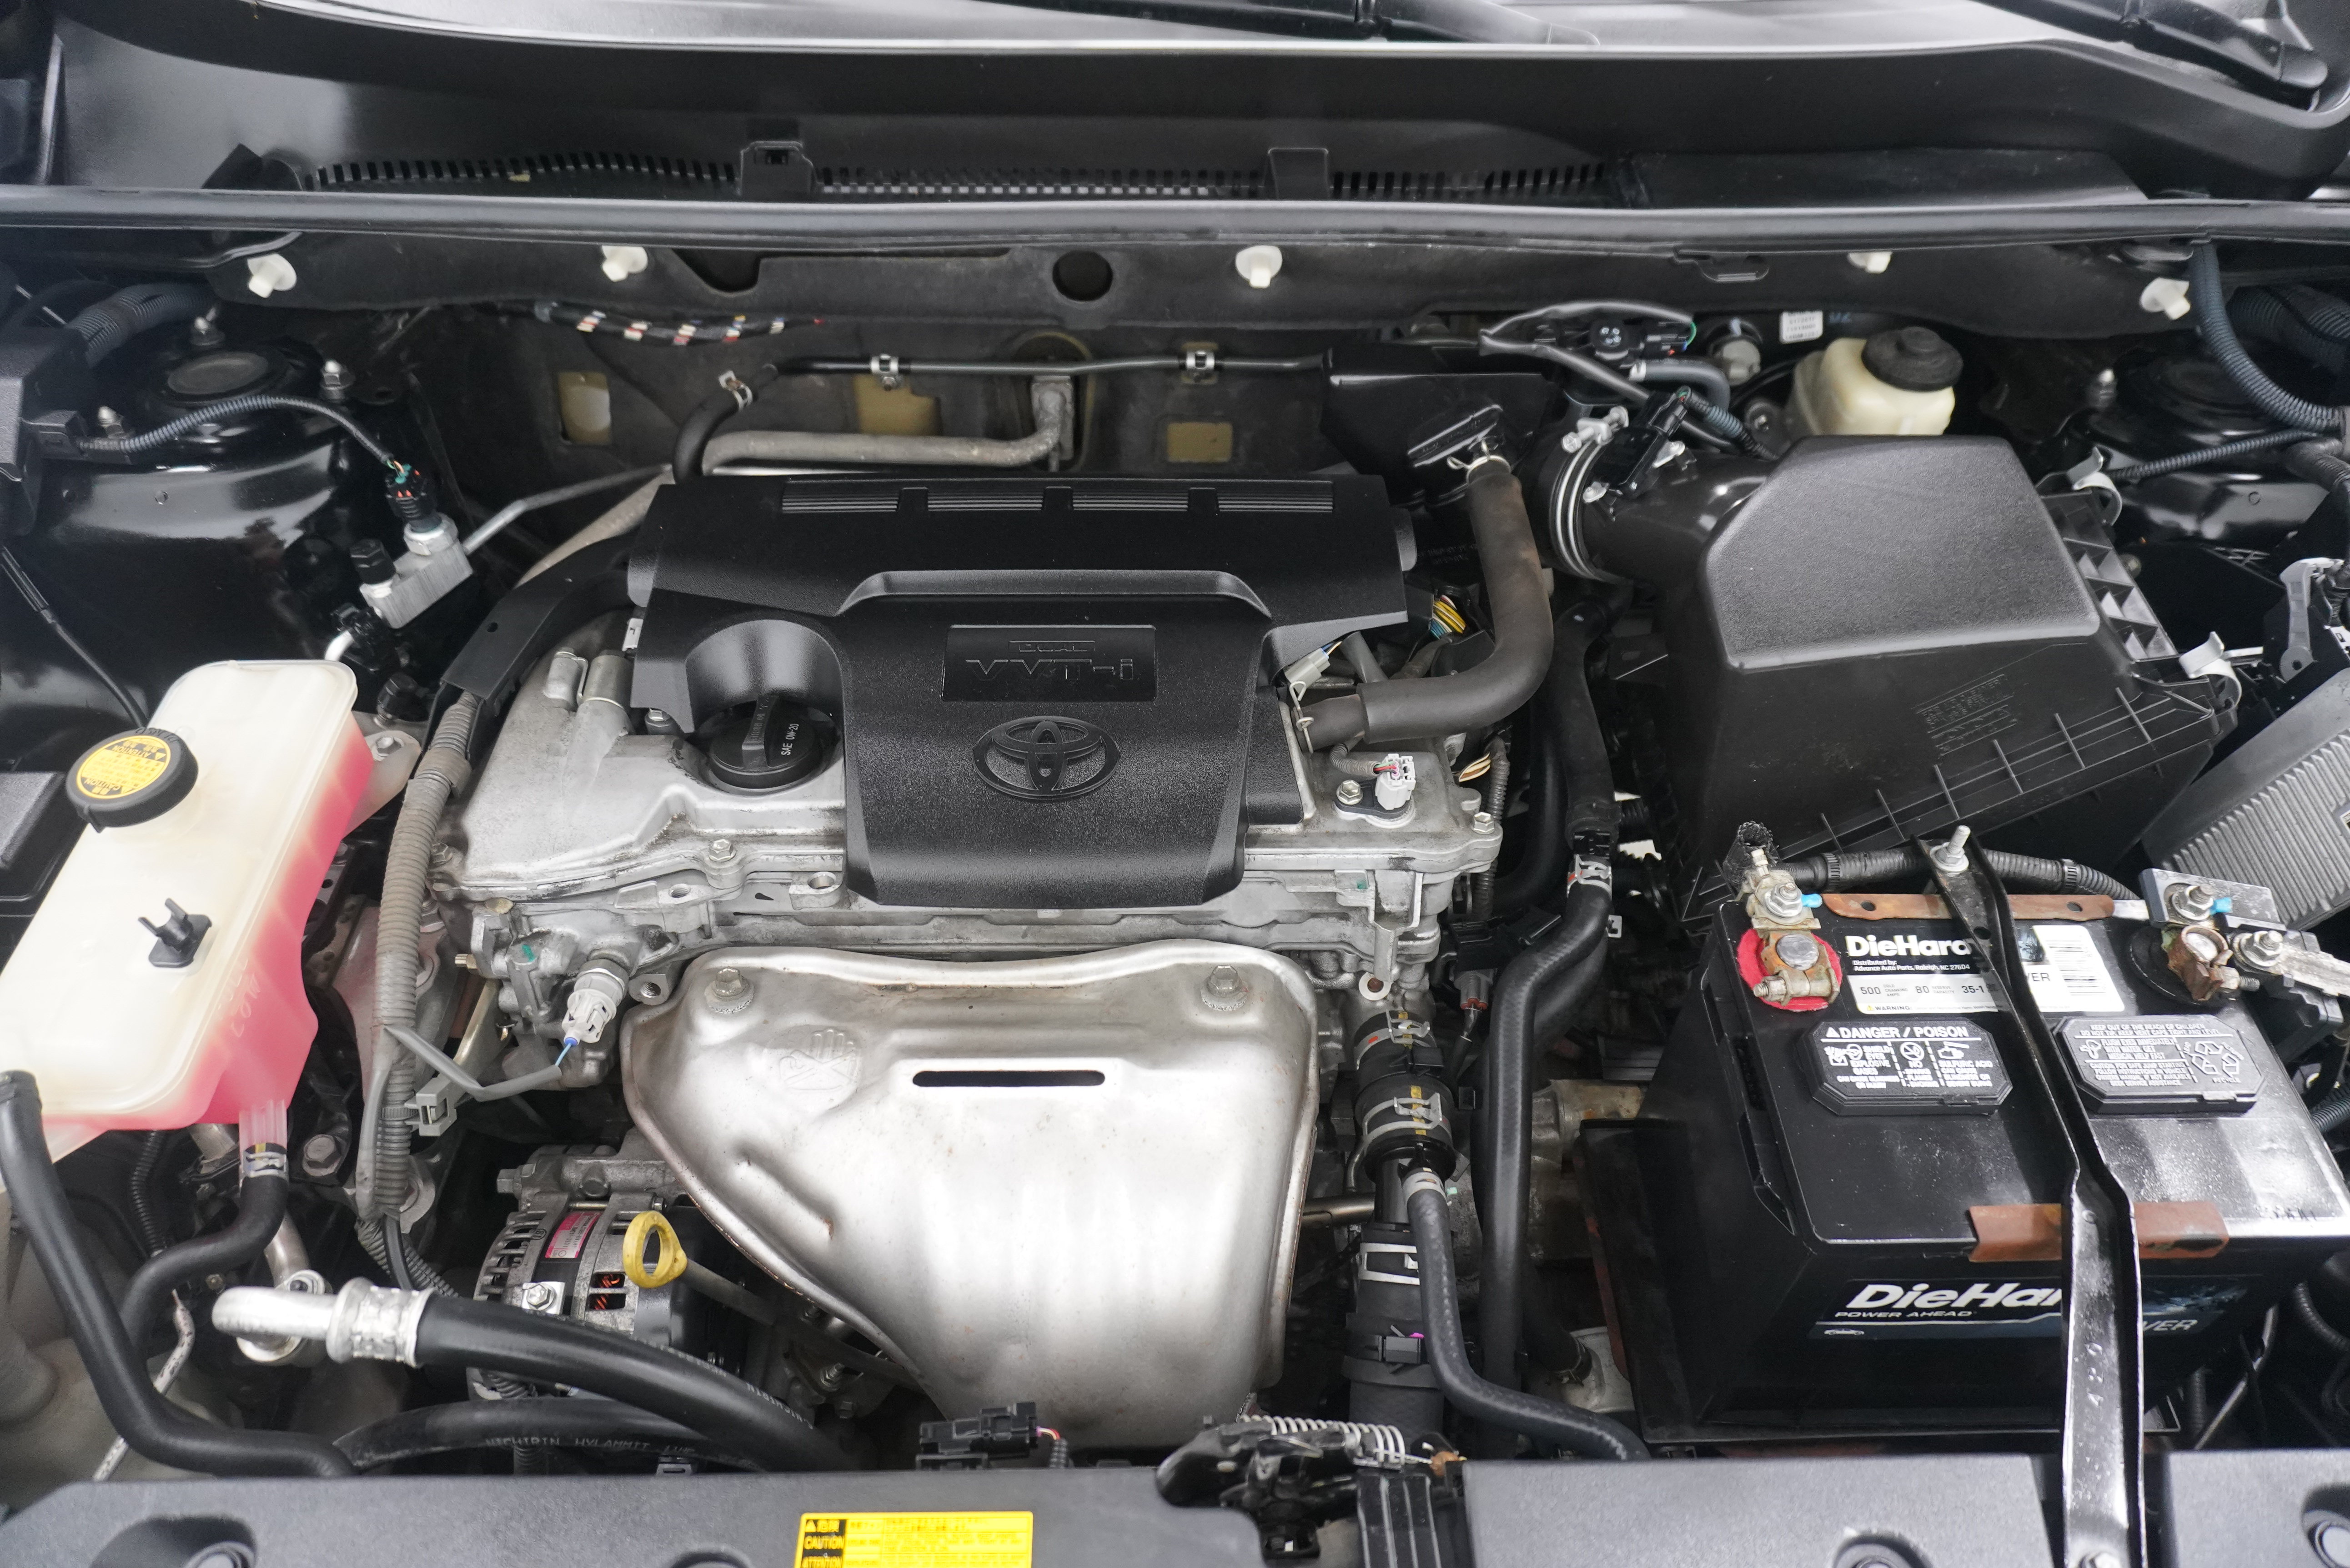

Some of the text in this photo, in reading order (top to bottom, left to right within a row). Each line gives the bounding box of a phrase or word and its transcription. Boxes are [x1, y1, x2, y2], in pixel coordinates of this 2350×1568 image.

[1019, 643, 1088, 652] DUAL
[965, 659, 1133, 681] VVT-i
[112, 745, 152, 758] ATTENTION
[781, 743, 793, 756] SAE
[83, 778, 121, 790] CAUTION
[1860, 986, 1881, 995] 500
[1839, 1026, 1901, 1038] DANGER
[1914, 1026, 1969, 1037] POISON
[1846, 1282, 2062, 1308] DieHar
[2143, 1319, 2198, 1332] VER
[804, 1535, 845, 1550] CAUTION
